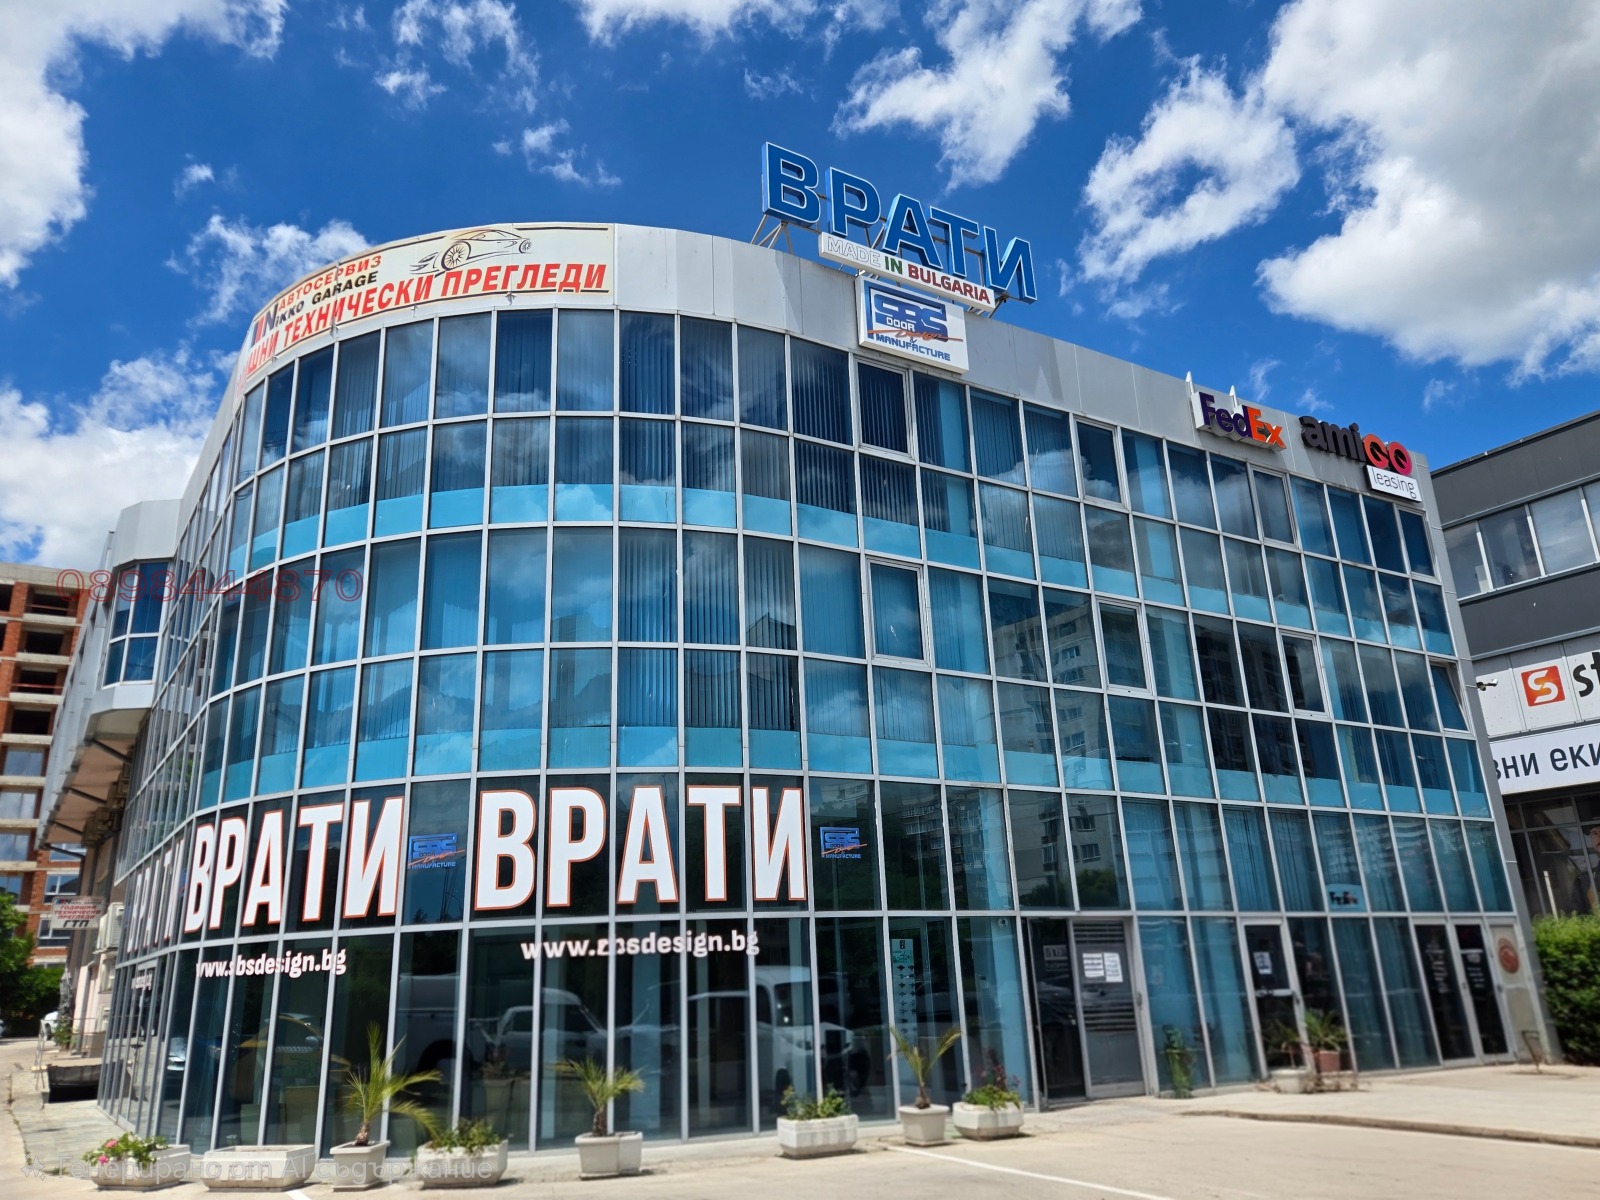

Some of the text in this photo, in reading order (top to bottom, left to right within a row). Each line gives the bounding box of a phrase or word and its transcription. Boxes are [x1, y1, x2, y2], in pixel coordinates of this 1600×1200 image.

[761, 142, 1037, 304] ВРАТИ
[278, 255, 382, 311] АВТОСЕРВИЗ
[311, 271, 379, 306] GARAGE
[827, 234, 991, 305] MADE IN BULGARIA
[283, 274, 435, 348] ТЕХНИЧЕСКИ
[440, 263, 607, 298] ПРЕГЛЕДИ
[886, 317, 916, 332] DOOR
[875, 334, 951, 362] MANUFACTURE
[1199, 391, 1287, 450] FedEx
[1372, 467, 1419, 501] leasing
[185, 796, 405, 933] ВРАТИ
[474, 785, 807, 911] ВРАТИ
[63, 920, 90, 928] ГТП
